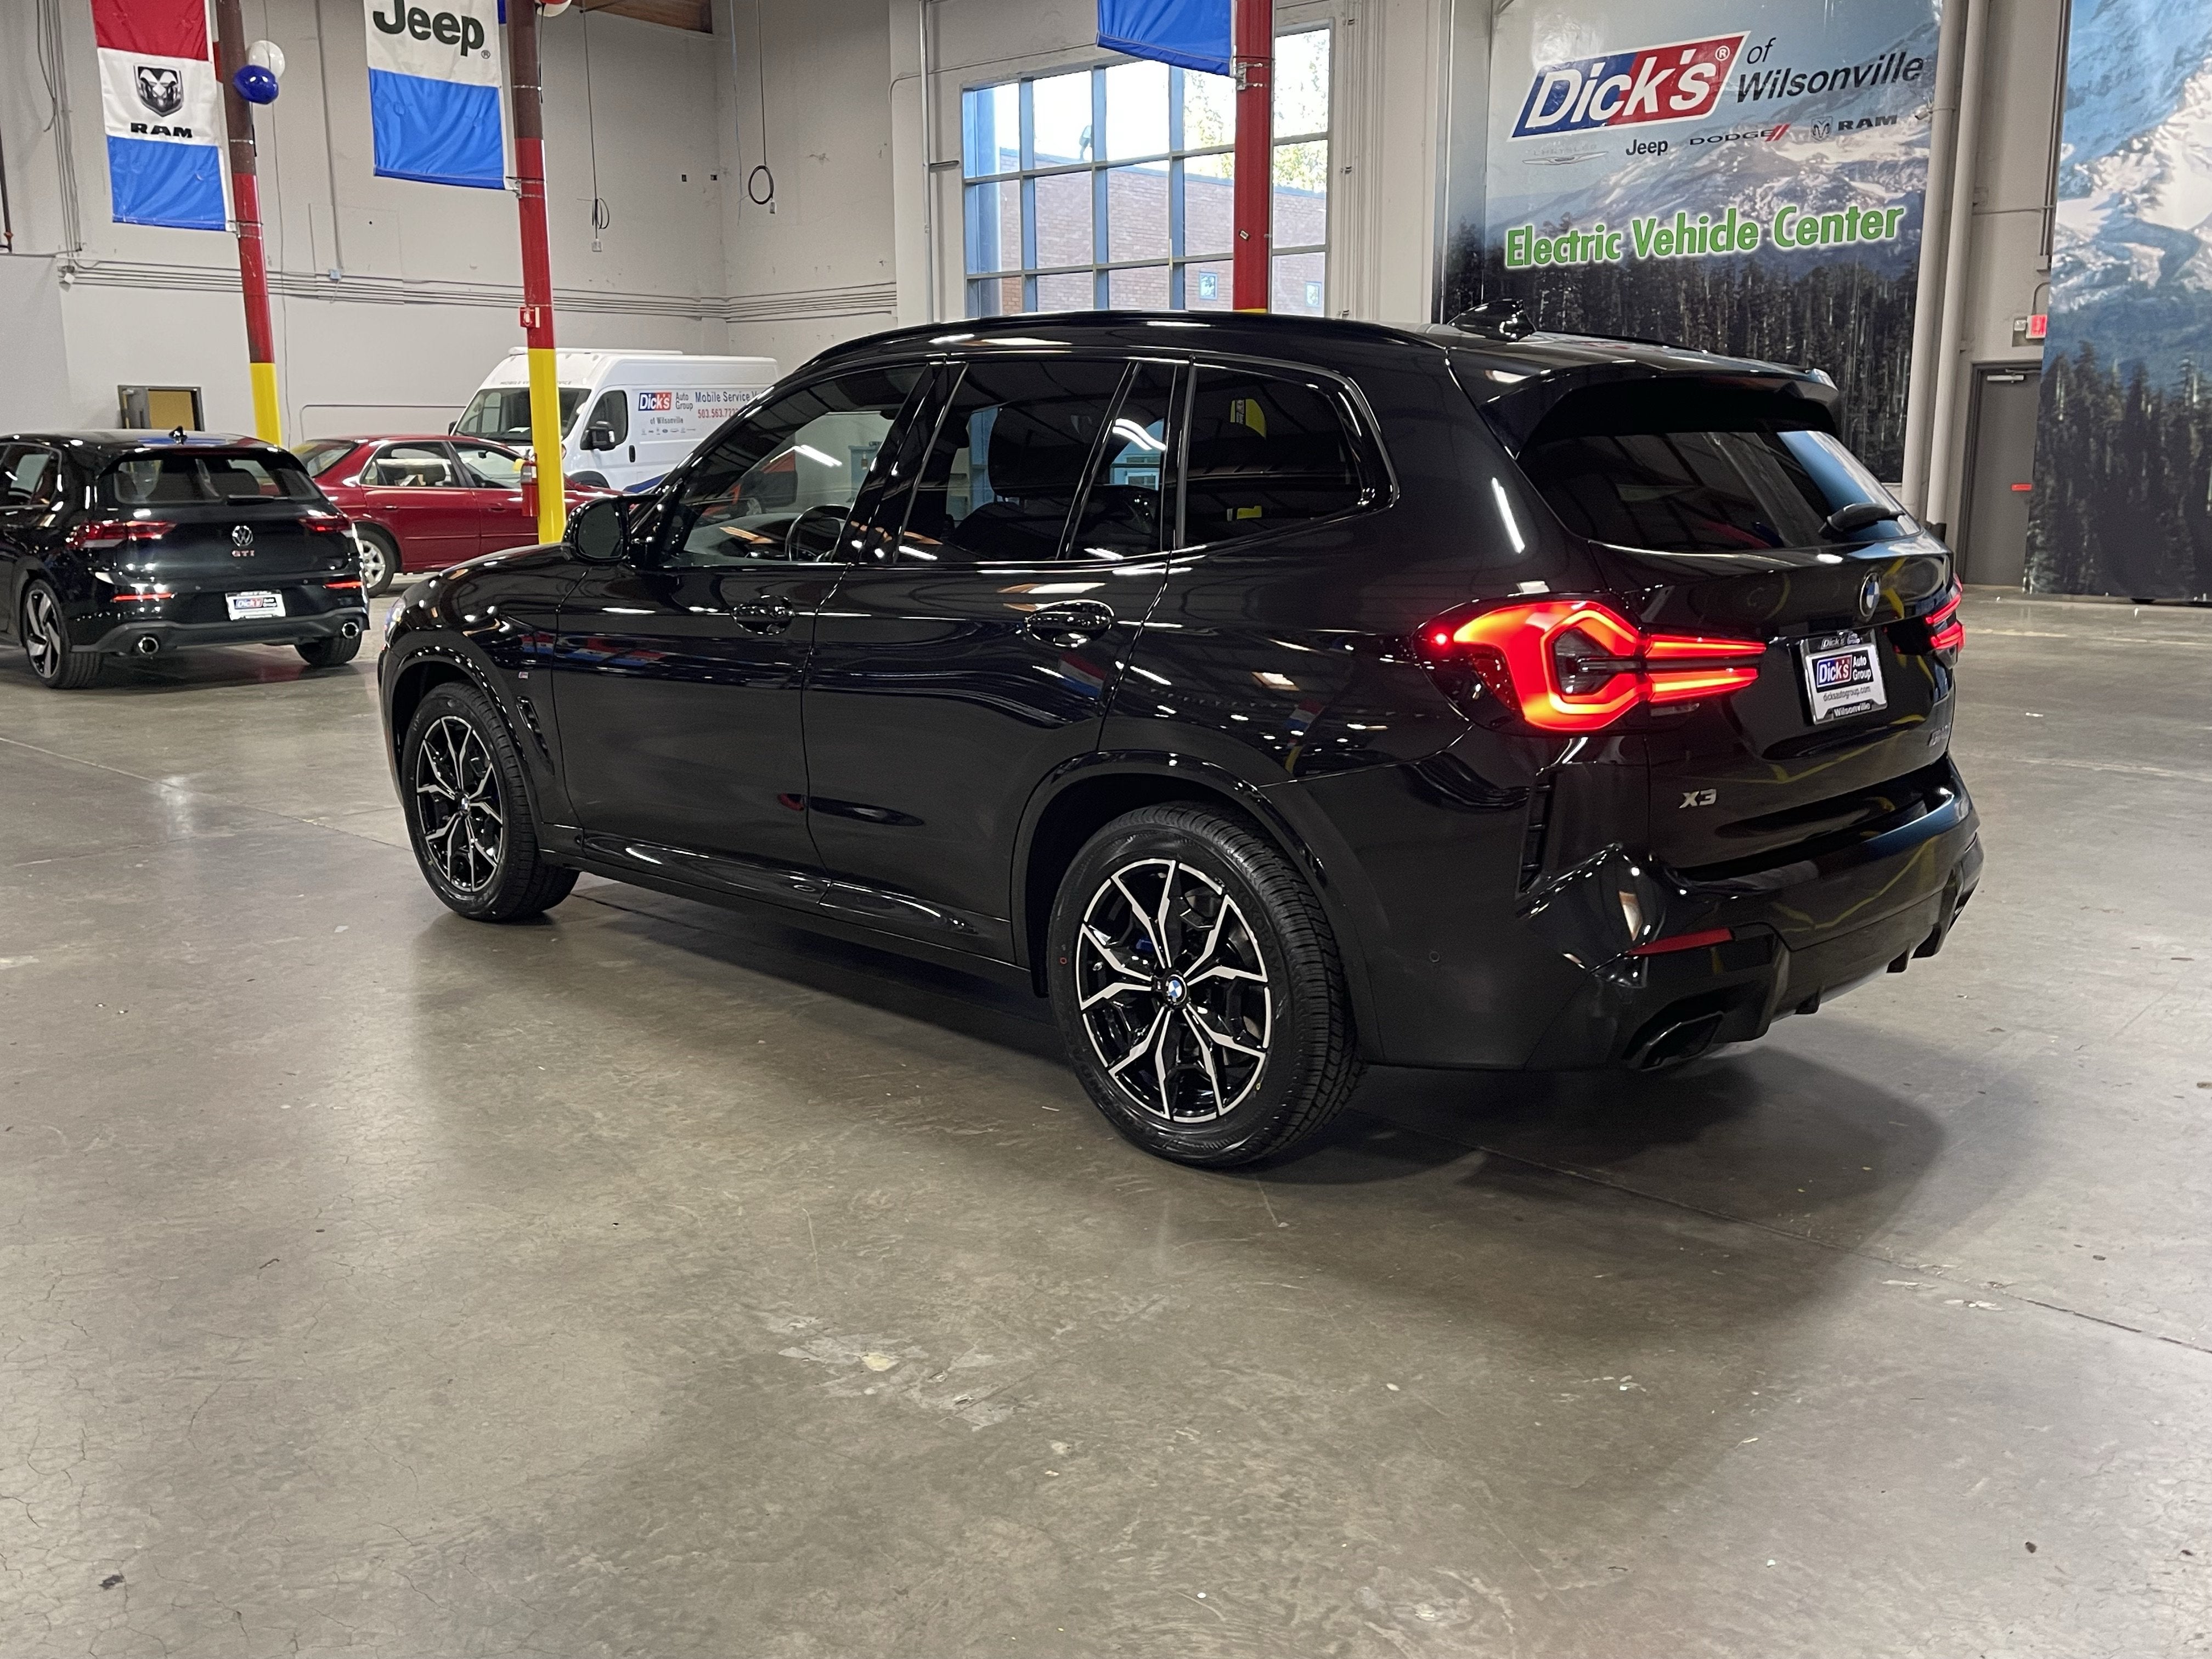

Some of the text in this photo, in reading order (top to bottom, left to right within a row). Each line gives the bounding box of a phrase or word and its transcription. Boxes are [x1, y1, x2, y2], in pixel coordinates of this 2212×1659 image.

[373, 0, 484, 57] Jeep
[1747, 37, 1777, 65] of
[1737, 51, 1924, 103] Wilsonville
[1525, 49, 1717, 128] Dick's
[131, 122, 193, 138] RAM
[1838, 114, 1898, 131] RAM
[1690, 129, 1775, 145] DODGE
[1626, 138, 1668, 156] Jeep
[1506, 206, 1904, 267] Electric Vehicle Center
[640, 393, 670, 410] Dick's
[675, 392, 689, 401] Auto
[695, 391, 721, 402] Mobile
[723, 391, 750, 402] Service
[675, 400, 693, 411] Group
[1853, 656, 1867, 668] Auto
[1819, 659, 1849, 684] Dick's
[1853, 668, 1871, 681] Group
[1823, 686, 1871, 702] dicksautogroup.com
[1834, 702, 1871, 717] Wilsonville
[1678, 788, 1717, 809] X3
